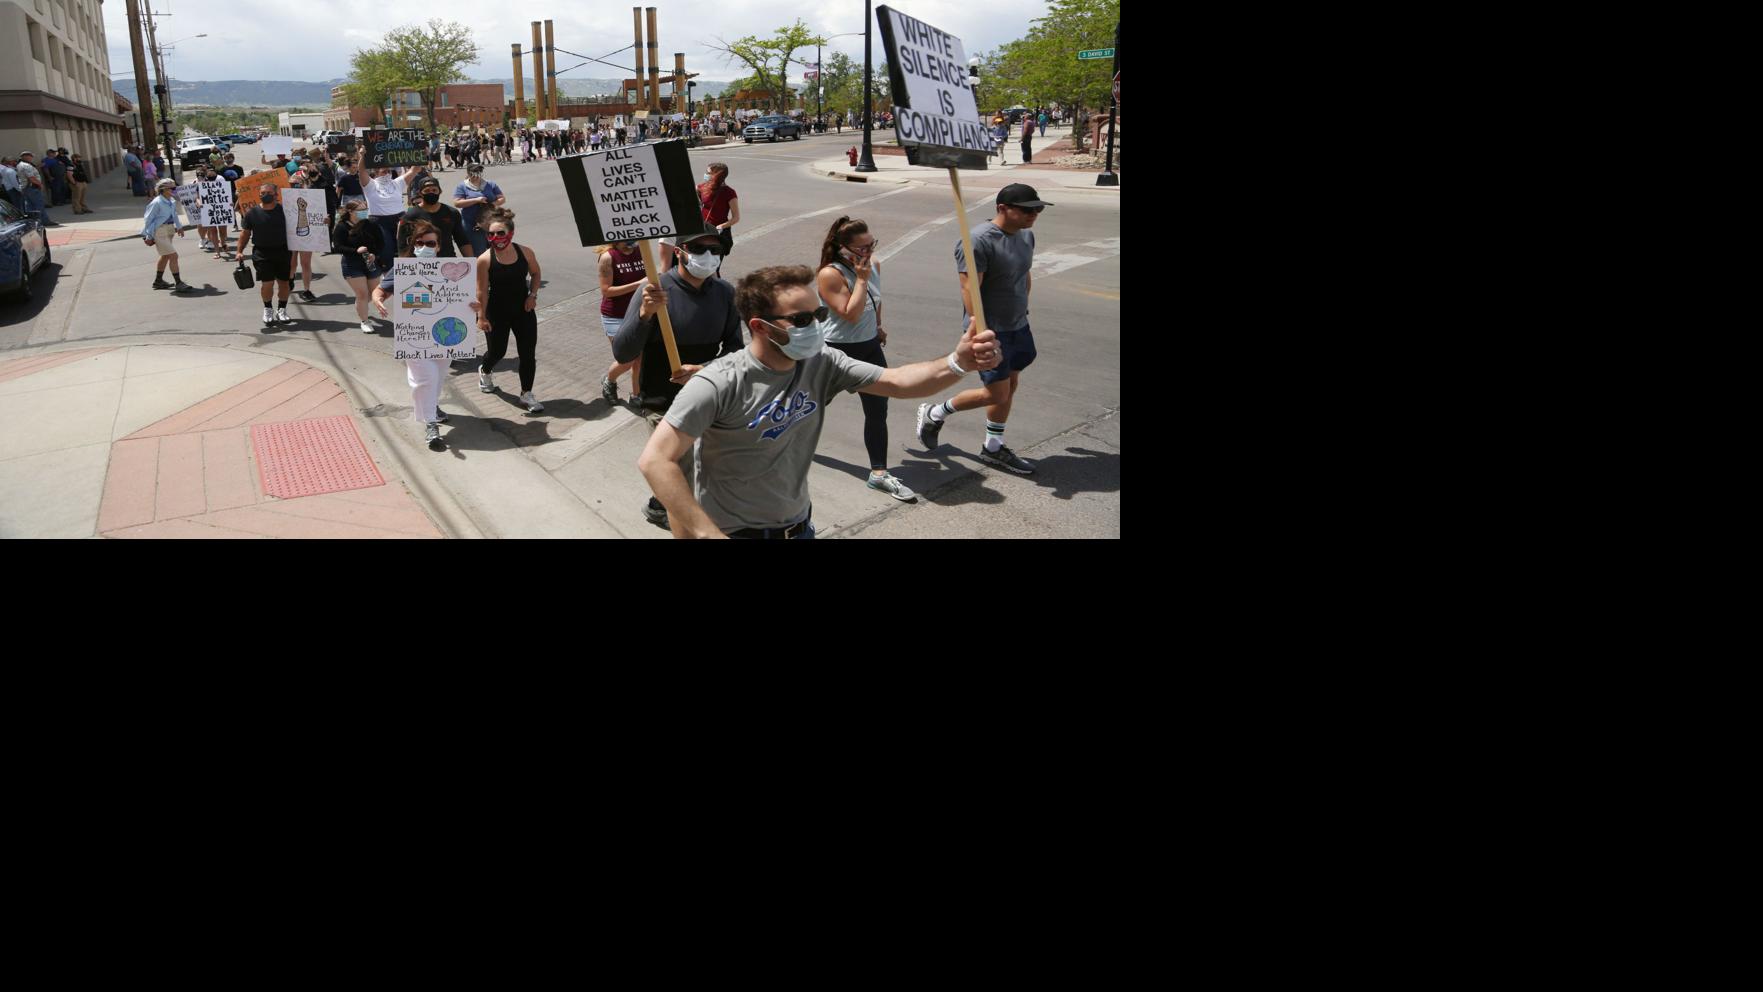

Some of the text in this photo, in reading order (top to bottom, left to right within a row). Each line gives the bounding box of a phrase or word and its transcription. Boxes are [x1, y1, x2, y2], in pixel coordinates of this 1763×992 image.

[899, 14, 953, 59] WHITE
[900, 45, 969, 90] SILENCE
[937, 89, 955, 117] IS
[368, 130, 425, 143] WE ARE THE
[375, 141, 415, 151] GENERATION
[374, 150, 427, 164] OF CHANGE
[605, 149, 632, 161] ALL
[602, 162, 643, 177] LIVES
[603, 173, 646, 188] CAN'T
[201, 194, 229, 204] Matter
[600, 186, 658, 203] MATTER
[611, 200, 654, 213] UNITL
[612, 213, 660, 227] BLACK
[606, 225, 671, 240] ONES DO
[395, 323, 425, 331] Nothing
[395, 348, 476, 360] Black Lives Matter!
